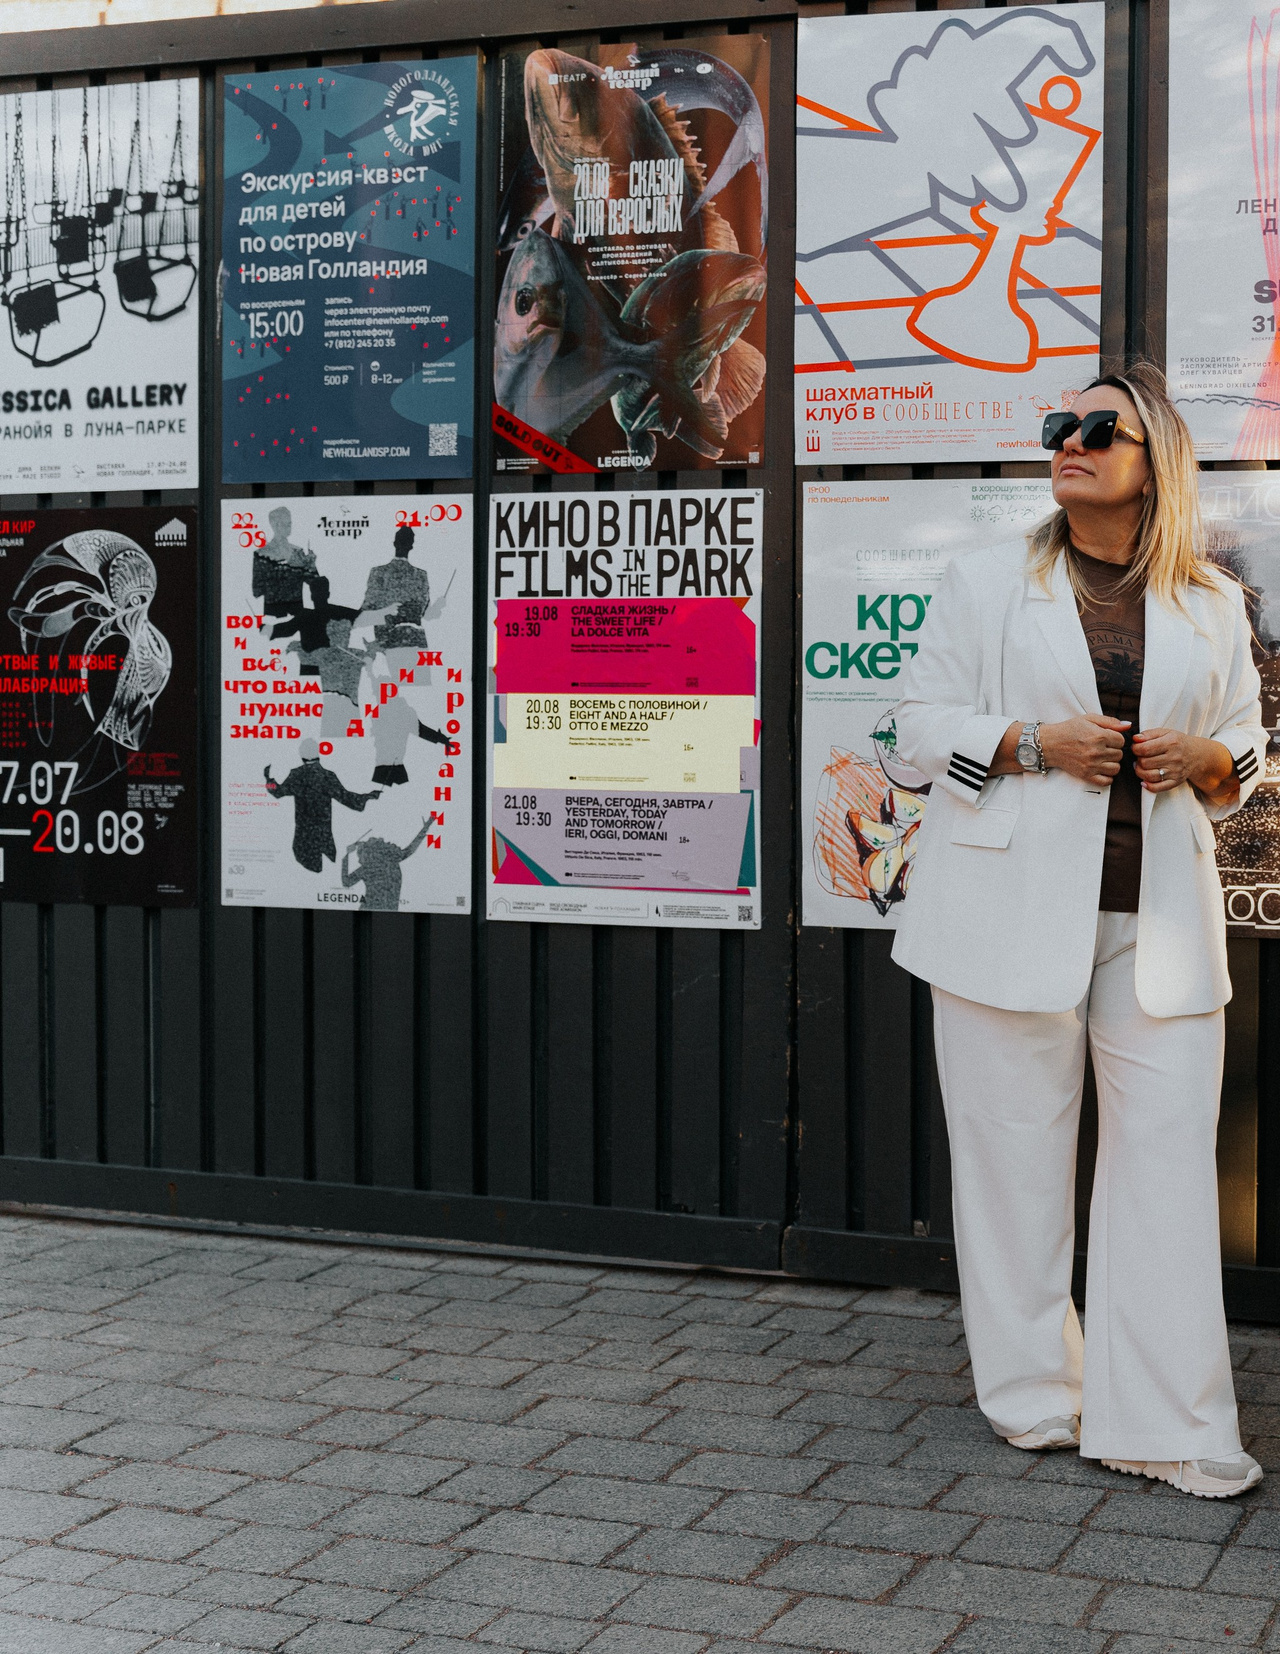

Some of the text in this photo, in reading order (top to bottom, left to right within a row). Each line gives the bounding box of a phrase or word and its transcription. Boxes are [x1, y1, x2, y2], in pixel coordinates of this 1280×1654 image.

[601, 63, 660, 81] Летний
[608, 77, 652, 90] театр
[240, 166, 429, 195] Экскурсия-квест
[573, 162, 610, 201] 20.08
[629, 158, 684, 198] СКАЗКИ
[239, 195, 346, 226] для детей
[573, 195, 683, 244] ДЛЯ ВЗРОСЛЫХ
[240, 230, 358, 255] по острову
[240, 258, 428, 284] Новая Голландия
[249, 310, 304, 338] 15:00
[2, 383, 187, 413] SSICA GALLERY
[806, 382, 933, 402] шахматный
[806, 400, 1014, 424] клуб в СООБЩЕСТВЕ
[0, 419, 187, 440] АНОЙЯ В ЛУНА-ПАРКЕ
[495, 414, 563, 462] SOLD OUT
[322, 447, 410, 458] NEWHOLLANDSP.COM
[598, 456, 651, 468] LEGENDA
[820, 495, 890, 504] понедельникам
[317, 515, 369, 528] Летний
[395, 503, 462, 528] 21:00
[495, 497, 755, 548] КИНО В ПАРКЕ
[12, 520, 36, 534] КИР
[323, 528, 362, 539] театр
[494, 548, 753, 598] FILMS IN PARK
[616, 574, 650, 597] THE
[524, 606, 558, 621] 19.08
[571, 605, 669, 617] СЛАДКАЯ ЖИЗНЬ
[226, 615, 266, 629] вот
[505, 623, 541, 637] 19:30
[587, 627, 624, 637] DOLCE
[234, 636, 247, 650] и
[1087, 634, 1134, 648] PALMA
[49, 654, 59, 670] И
[224, 680, 322, 694] что вам
[526, 699, 559, 714] 20.08
[569, 699, 701, 710] ВОСЕМЬ ПОЛОВИНОЙ
[240, 703, 323, 724] нужно
[526, 716, 562, 730] 19:30
[230, 724, 301, 739] знать
[504, 795, 537, 810] 21.08
[515, 812, 551, 827] 19:30
[565, 807, 629, 819] YESTERDAY,
[591, 819, 656, 829] TOMORROW
